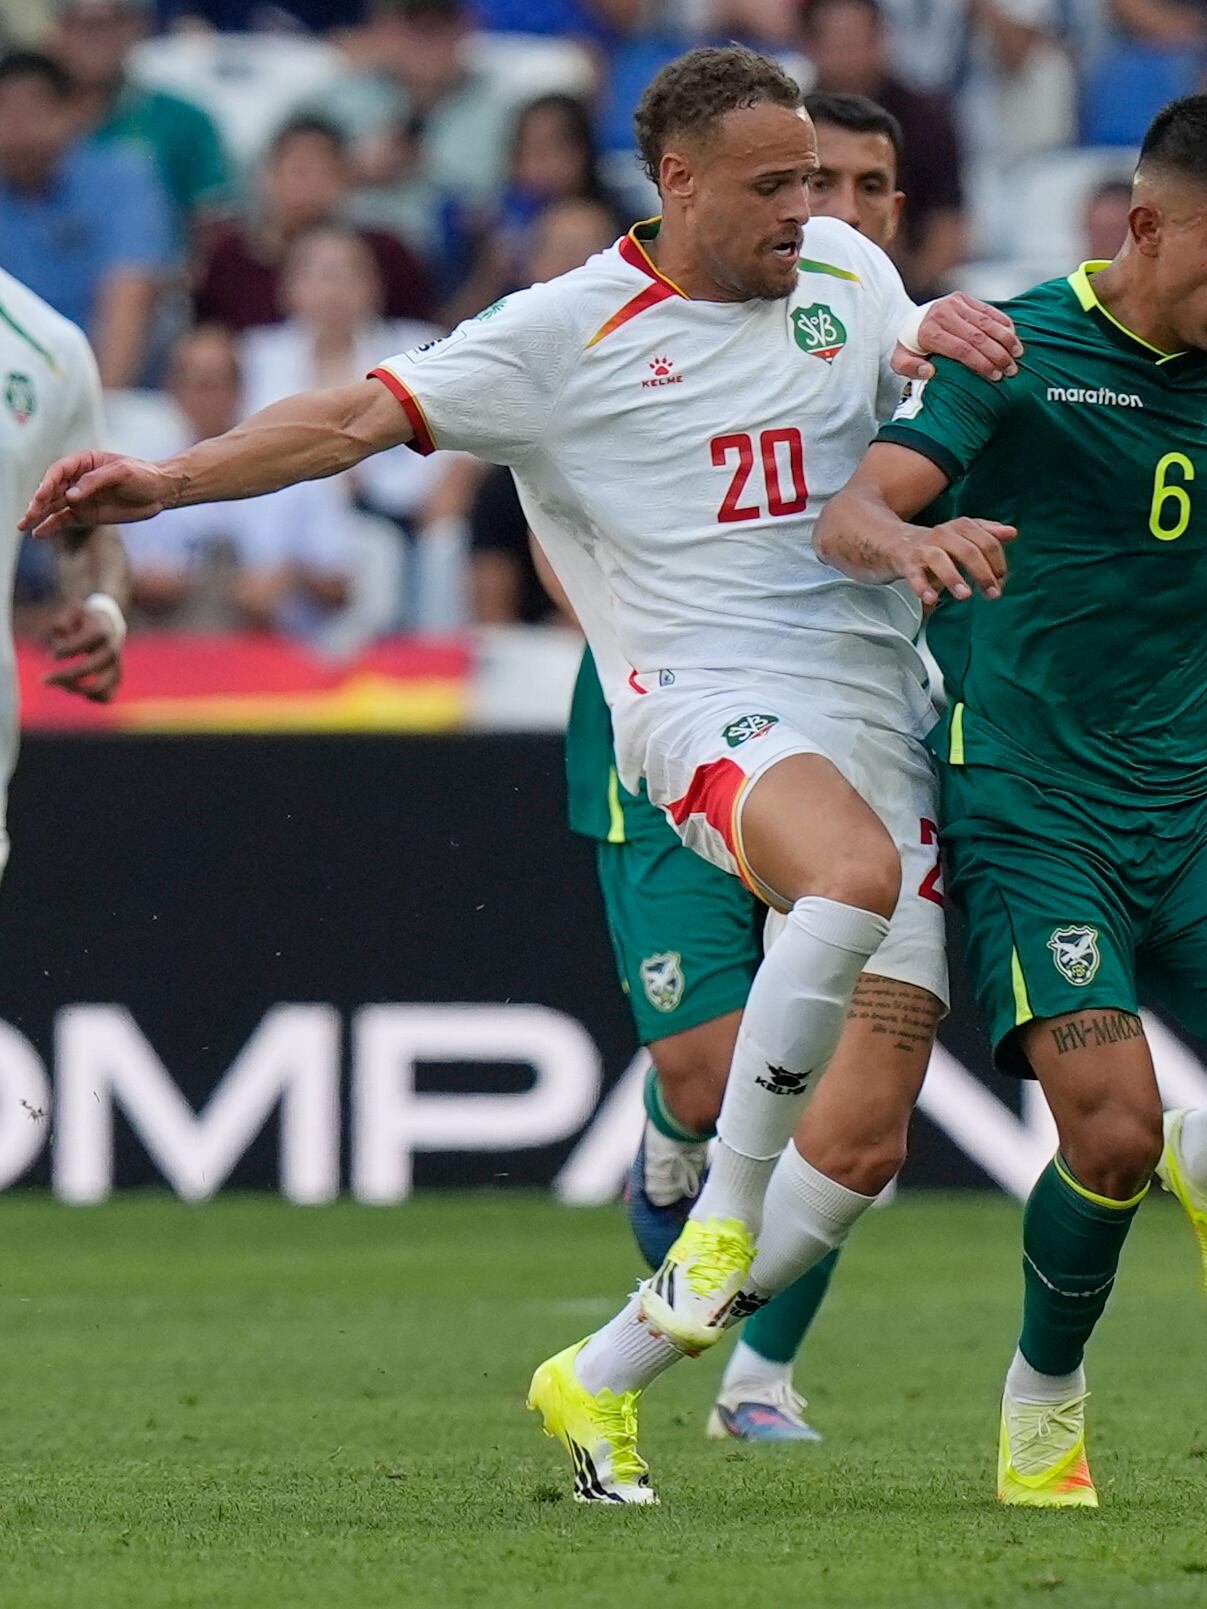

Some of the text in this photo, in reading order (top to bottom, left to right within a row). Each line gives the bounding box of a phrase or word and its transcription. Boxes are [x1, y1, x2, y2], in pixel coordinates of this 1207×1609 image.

[641, 376, 684, 388] KELME
[1046, 387, 1144, 408] marathon
[710, 427, 809, 523] 20
[1148, 452, 1195, 541] 6
[918, 817, 945, 909] 2
